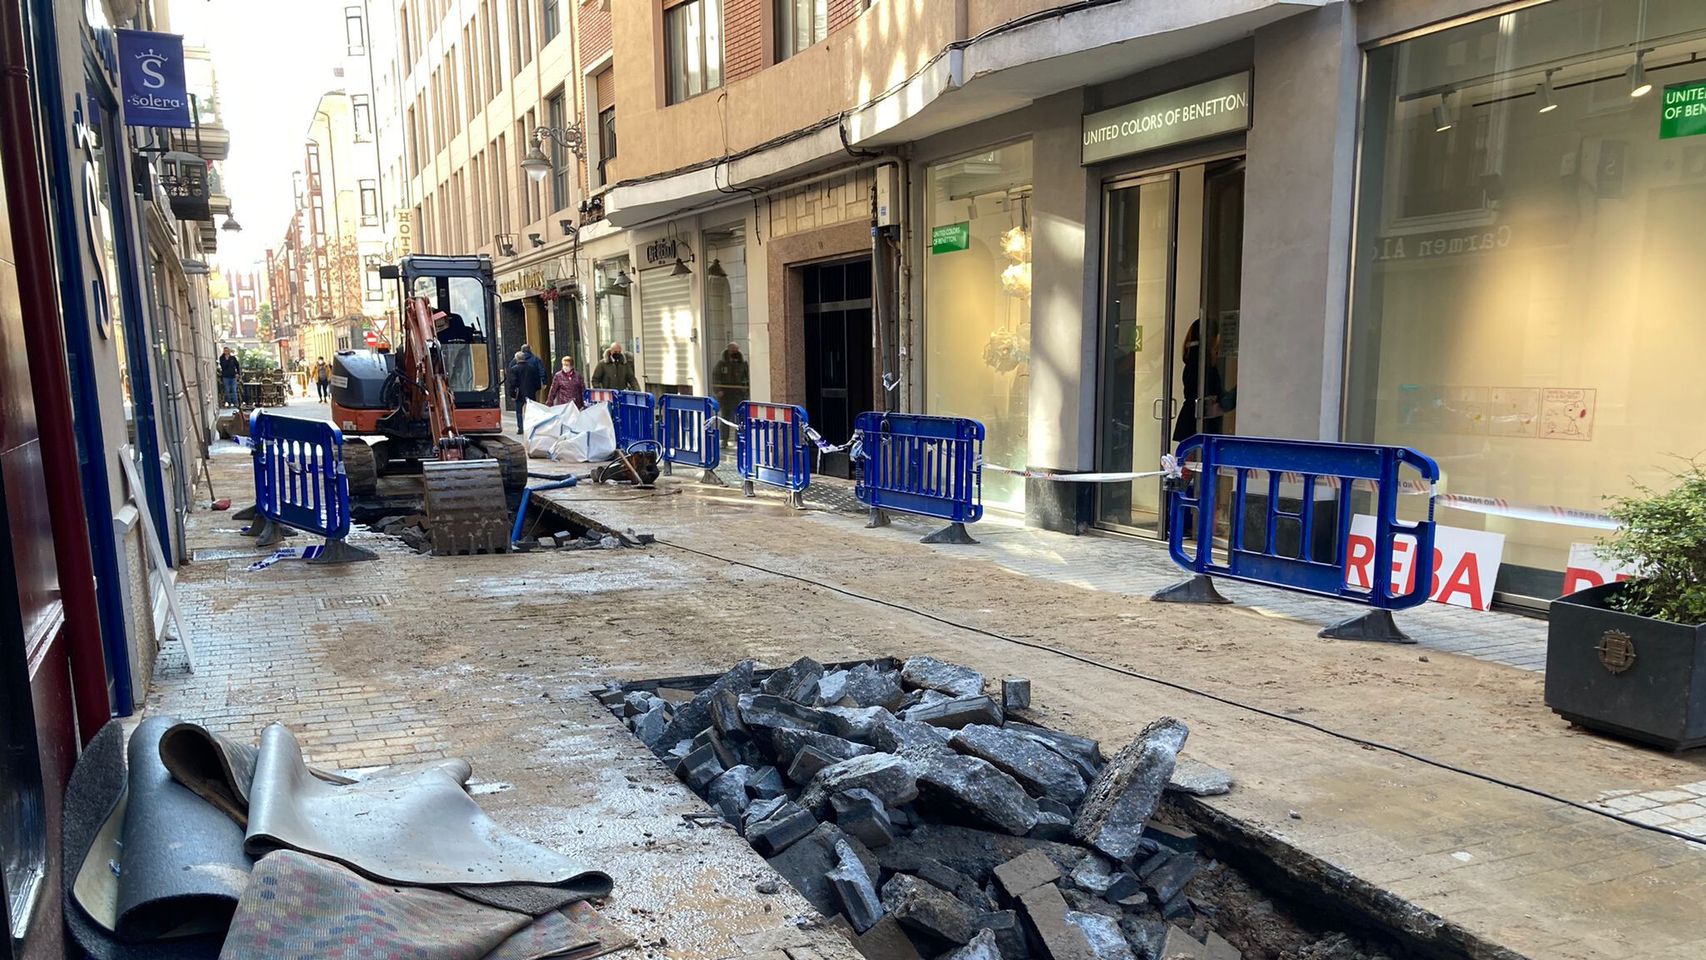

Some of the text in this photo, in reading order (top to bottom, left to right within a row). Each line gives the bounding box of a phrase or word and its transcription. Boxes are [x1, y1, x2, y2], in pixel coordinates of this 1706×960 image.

[141, 58, 165, 89] S
[132, 93, 180, 108] solera
[1666, 87, 1706, 104] UNITE
[1664, 105, 1683, 120] OF
[1083, 124, 1119, 146] UNITED
[1121, 112, 1163, 137] COLORS
[1164, 108, 1181, 126] OF
